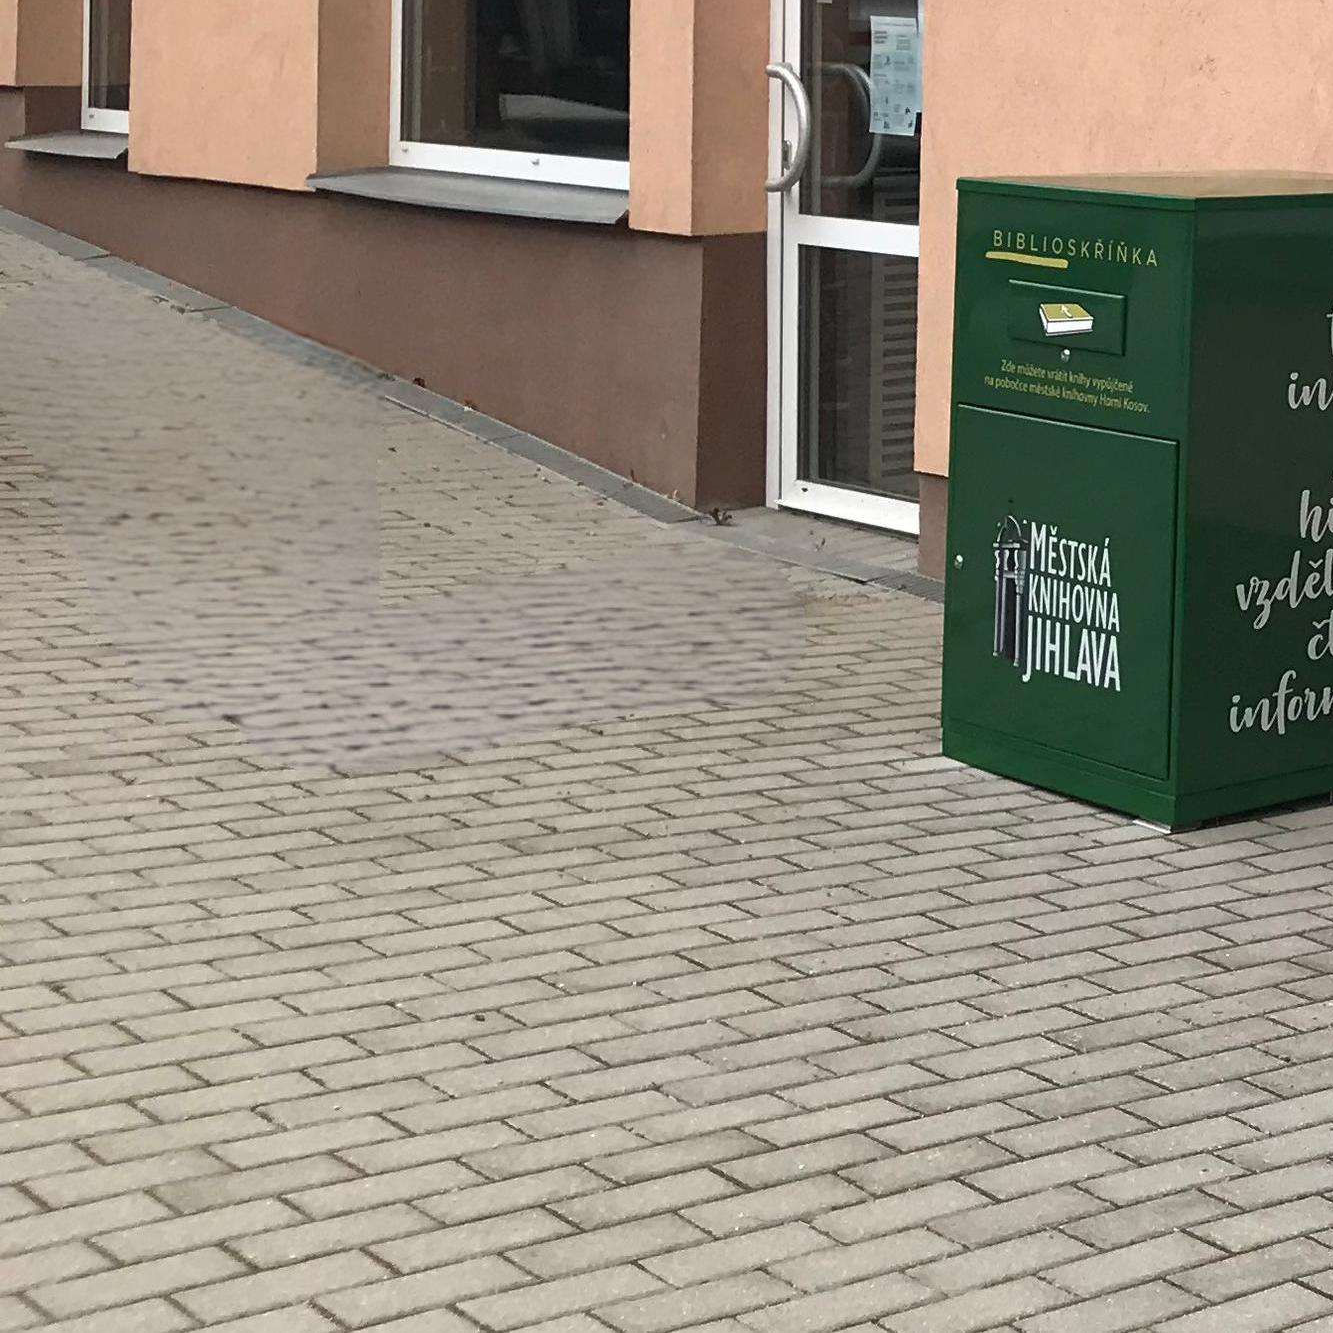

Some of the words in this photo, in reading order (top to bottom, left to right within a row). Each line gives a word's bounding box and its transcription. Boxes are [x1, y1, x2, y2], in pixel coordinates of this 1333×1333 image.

[993, 229, 1158, 267] BIBLIOSKŘÍŇKA
[1029, 520, 1112, 588] MĚSTSKÁ
[1028, 573, 1120, 633] KNIHOVNA
[1022, 615, 1121, 692] JIHLAVA
